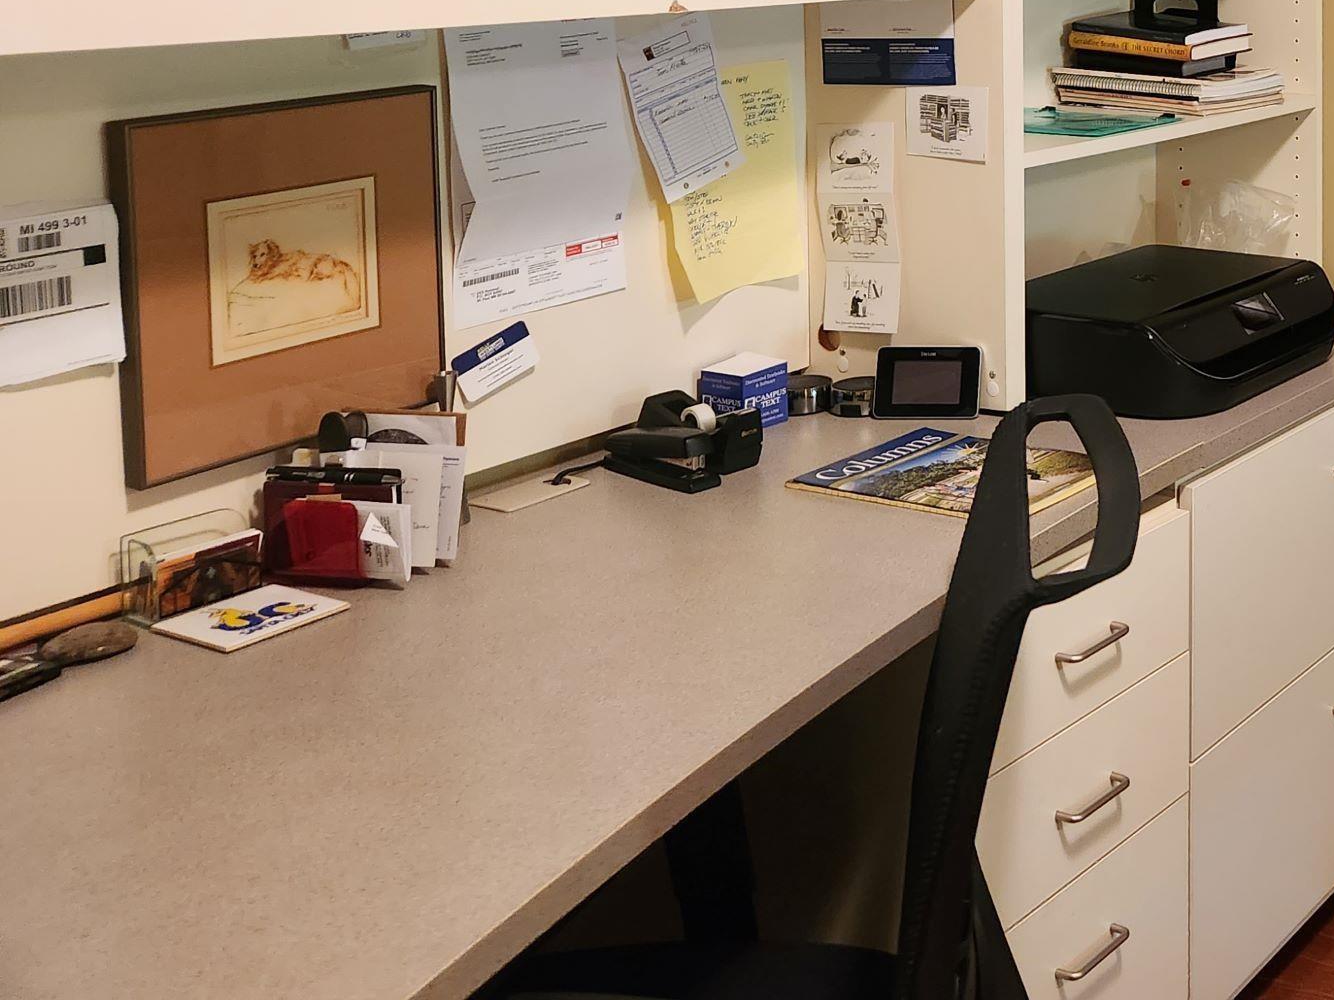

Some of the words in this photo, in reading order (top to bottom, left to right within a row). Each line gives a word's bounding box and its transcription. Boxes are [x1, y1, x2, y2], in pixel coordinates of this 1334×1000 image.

[20, 224, 34, 235] MI
[38, 220, 59, 231] 499
[62, 215, 87, 228] 3-01
[711, 396, 741, 407] CAMPUS
[755, 387, 786, 403] CAMPUS
[761, 397, 781, 408] TEXT
[815, 433, 944, 481] Columns
